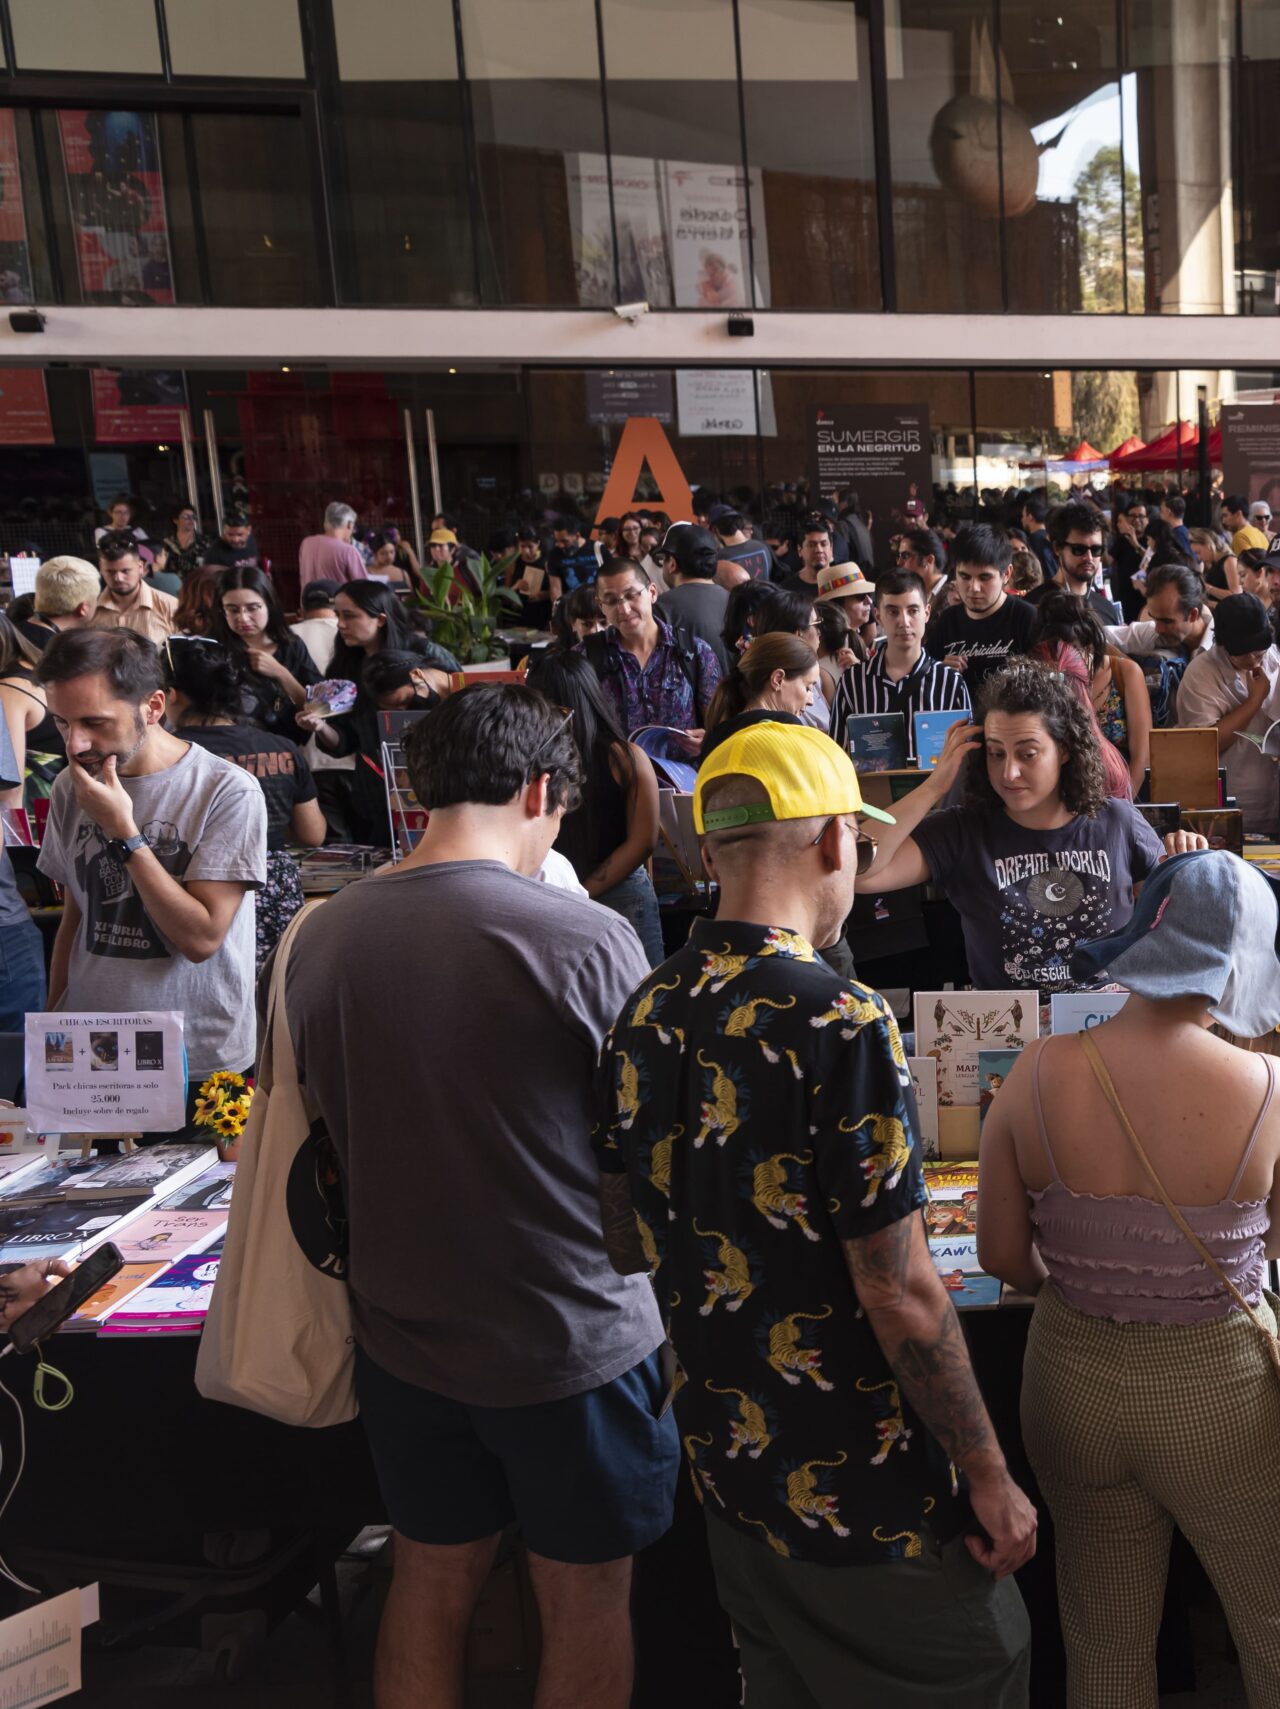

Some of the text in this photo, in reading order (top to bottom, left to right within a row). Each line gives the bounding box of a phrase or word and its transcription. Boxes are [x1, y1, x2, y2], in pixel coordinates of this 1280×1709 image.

[817, 430, 920, 443] SUMERGIR
[817, 443, 921, 453] EN LA NEGRITUD
[994, 849, 1111, 891] DREAM WORLD
[60, 1018, 153, 1026] CHICAS ESCRITORAS
[137, 1058, 157, 1066] LIBRO
[52, 1082, 71, 1090] Pack
[73, 1081, 97, 1090] chicas
[98, 1082, 135, 1090] escritoras
[90, 1095, 121, 1103] 25.000
[62, 1107, 92, 1117] Incluye
[93, 1107, 113, 1115] sobre
[126, 1107, 149, 1116] regalo
[152, 1219, 209, 1228] Trans
[7, 1229, 96, 1243] LIBRO X
